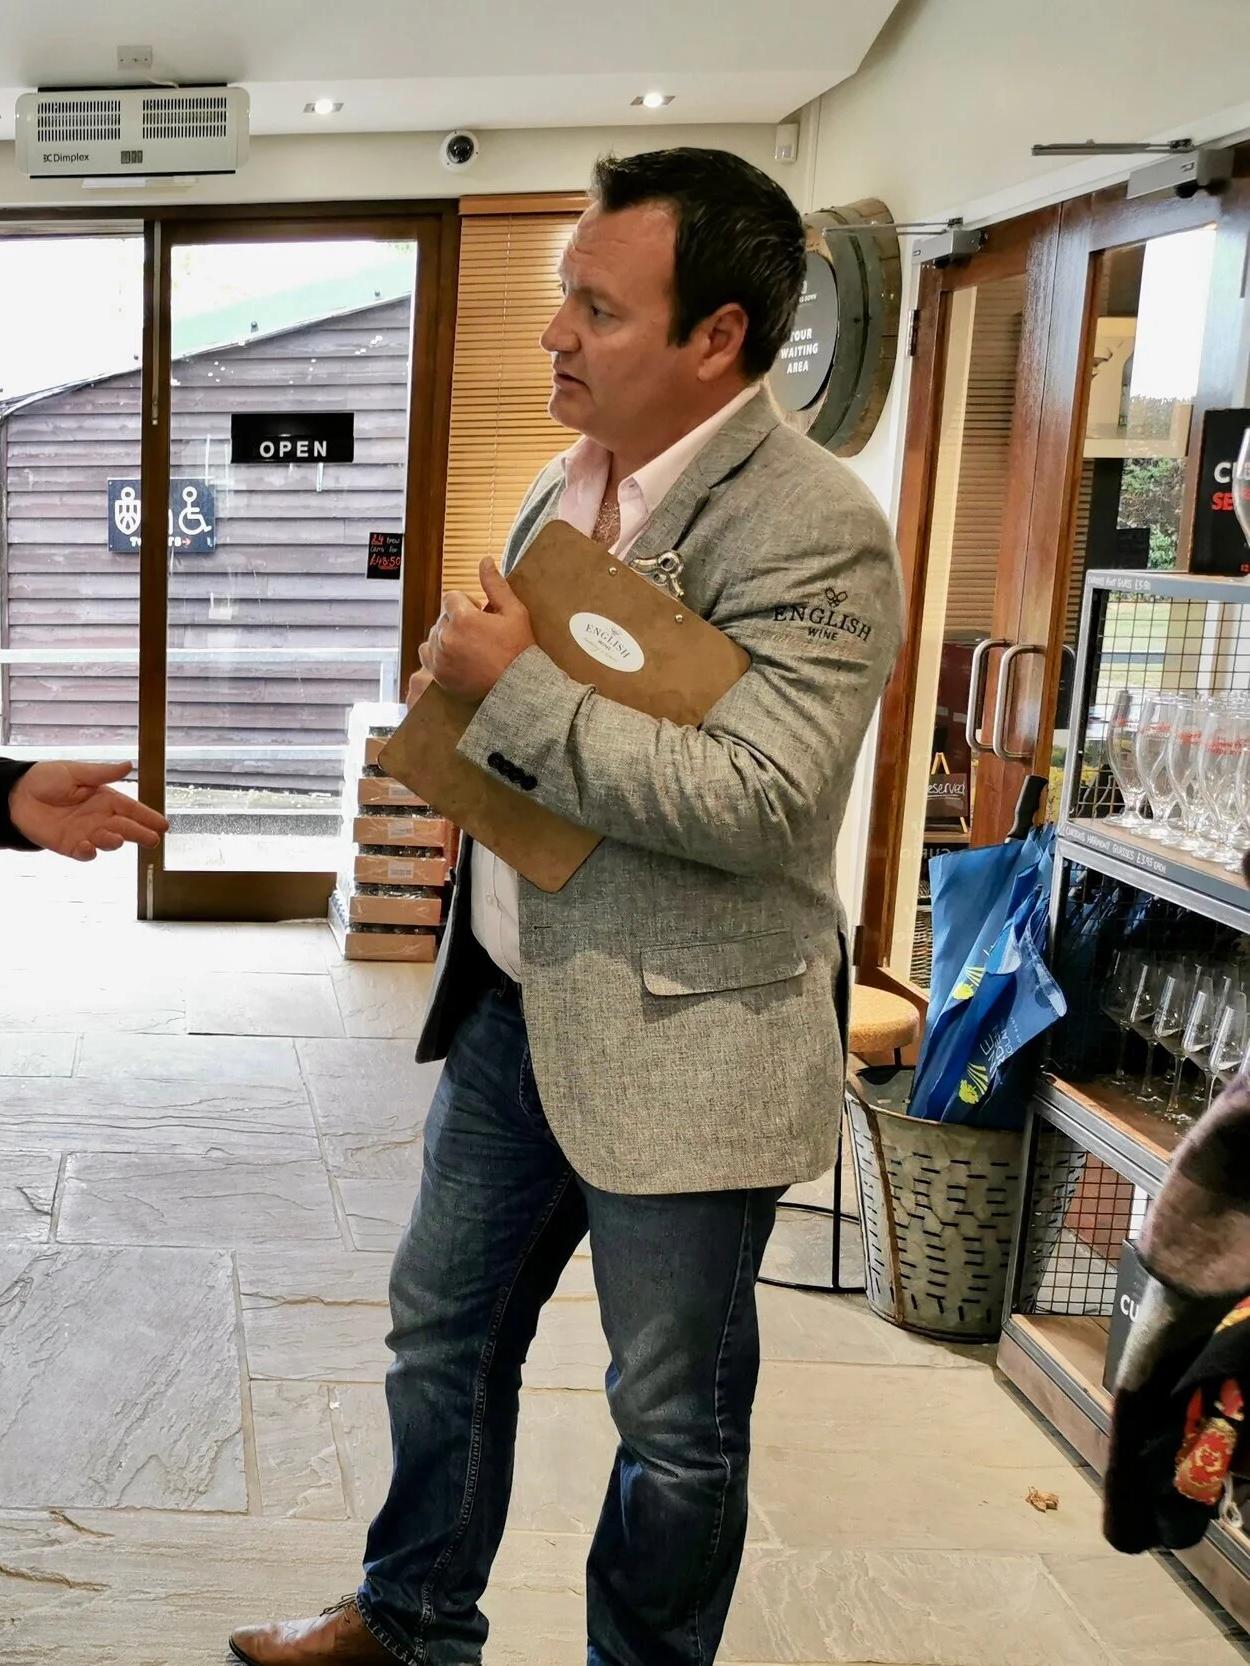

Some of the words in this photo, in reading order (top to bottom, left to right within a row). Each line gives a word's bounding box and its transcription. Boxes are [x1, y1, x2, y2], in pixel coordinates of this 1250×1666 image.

[53, 153, 89, 163] Dimplex
[780, 342, 819, 359] WAITING
[786, 360, 809, 374] AREA
[259, 440, 327, 458] OPEN
[773, 605, 872, 643] ENGLISH
[586, 624, 630, 658] ENGLISH
[807, 627, 838, 641] WINE
[928, 781, 965, 795] eserved
